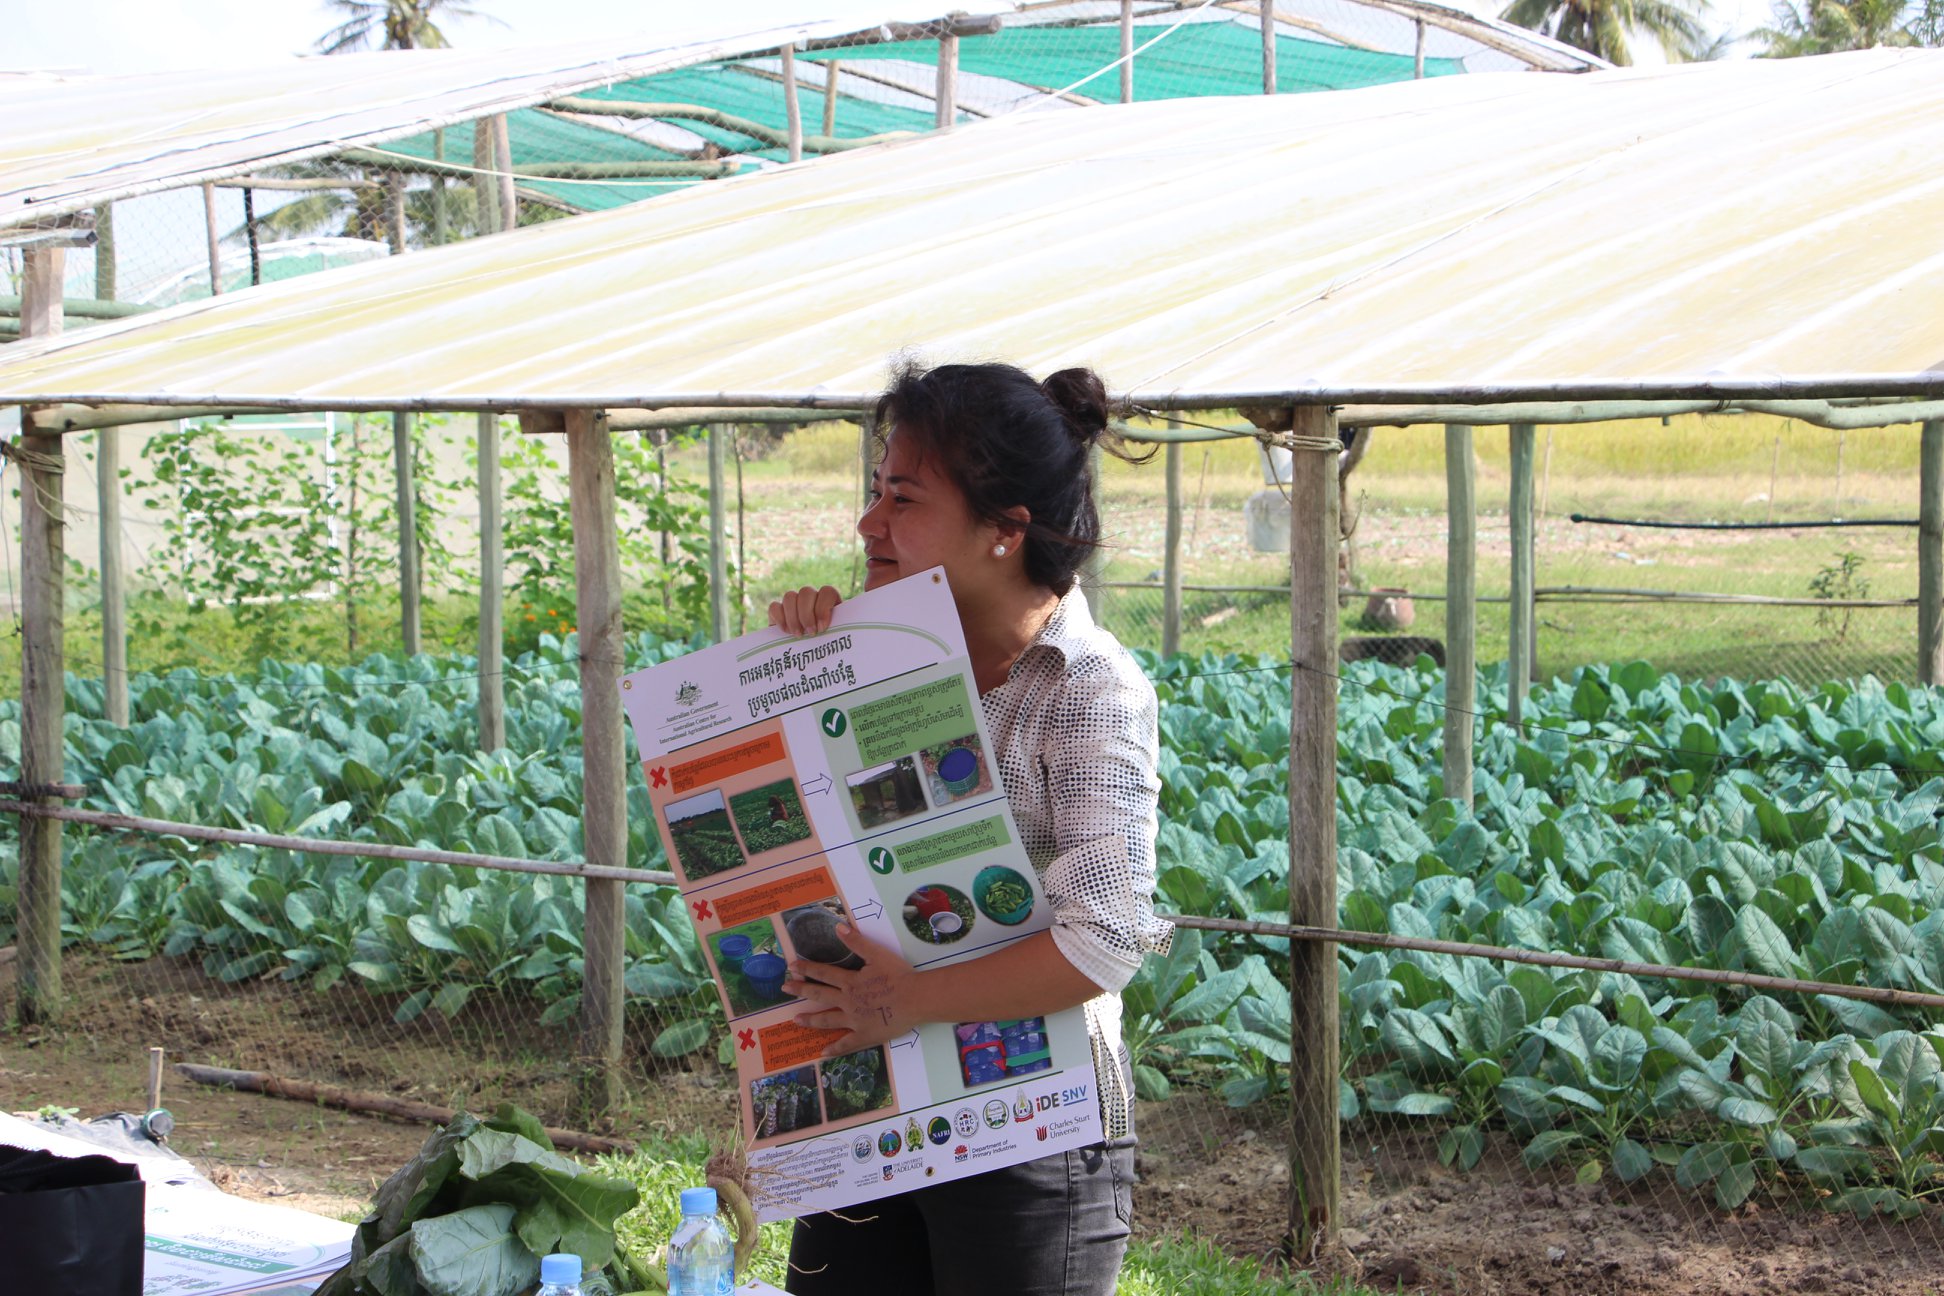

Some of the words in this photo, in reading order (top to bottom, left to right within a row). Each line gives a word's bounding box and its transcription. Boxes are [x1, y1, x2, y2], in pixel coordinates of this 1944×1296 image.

[666, 711, 690, 722] Australian
[690, 701, 719, 714] Government
[659, 731, 687, 744] International
[688, 722, 713, 735] Agricultural
[713, 716, 732, 727] Research
[673, 721, 695, 732] Australian
[1035, 1092, 1060, 1112] iDE
[1062, 1084, 1087, 1103] SNV
[958, 1118, 974, 1127] HRC
[1049, 1119, 1074, 1131] Charles
[1074, 1114, 1090, 1124] Sturt
[932, 1130, 951, 1139] NAFRI
[1050, 1126, 1080, 1139] University
[972, 1141, 1002, 1154] Department
[972, 1150, 992, 1160] Primary
[992, 1144, 1017, 1154] Industries
[901, 1157, 923, 1166] UNIVERSITY
[954, 1153, 969, 1161] NSW
[897, 1162, 923, 1174] ADELAIDE
